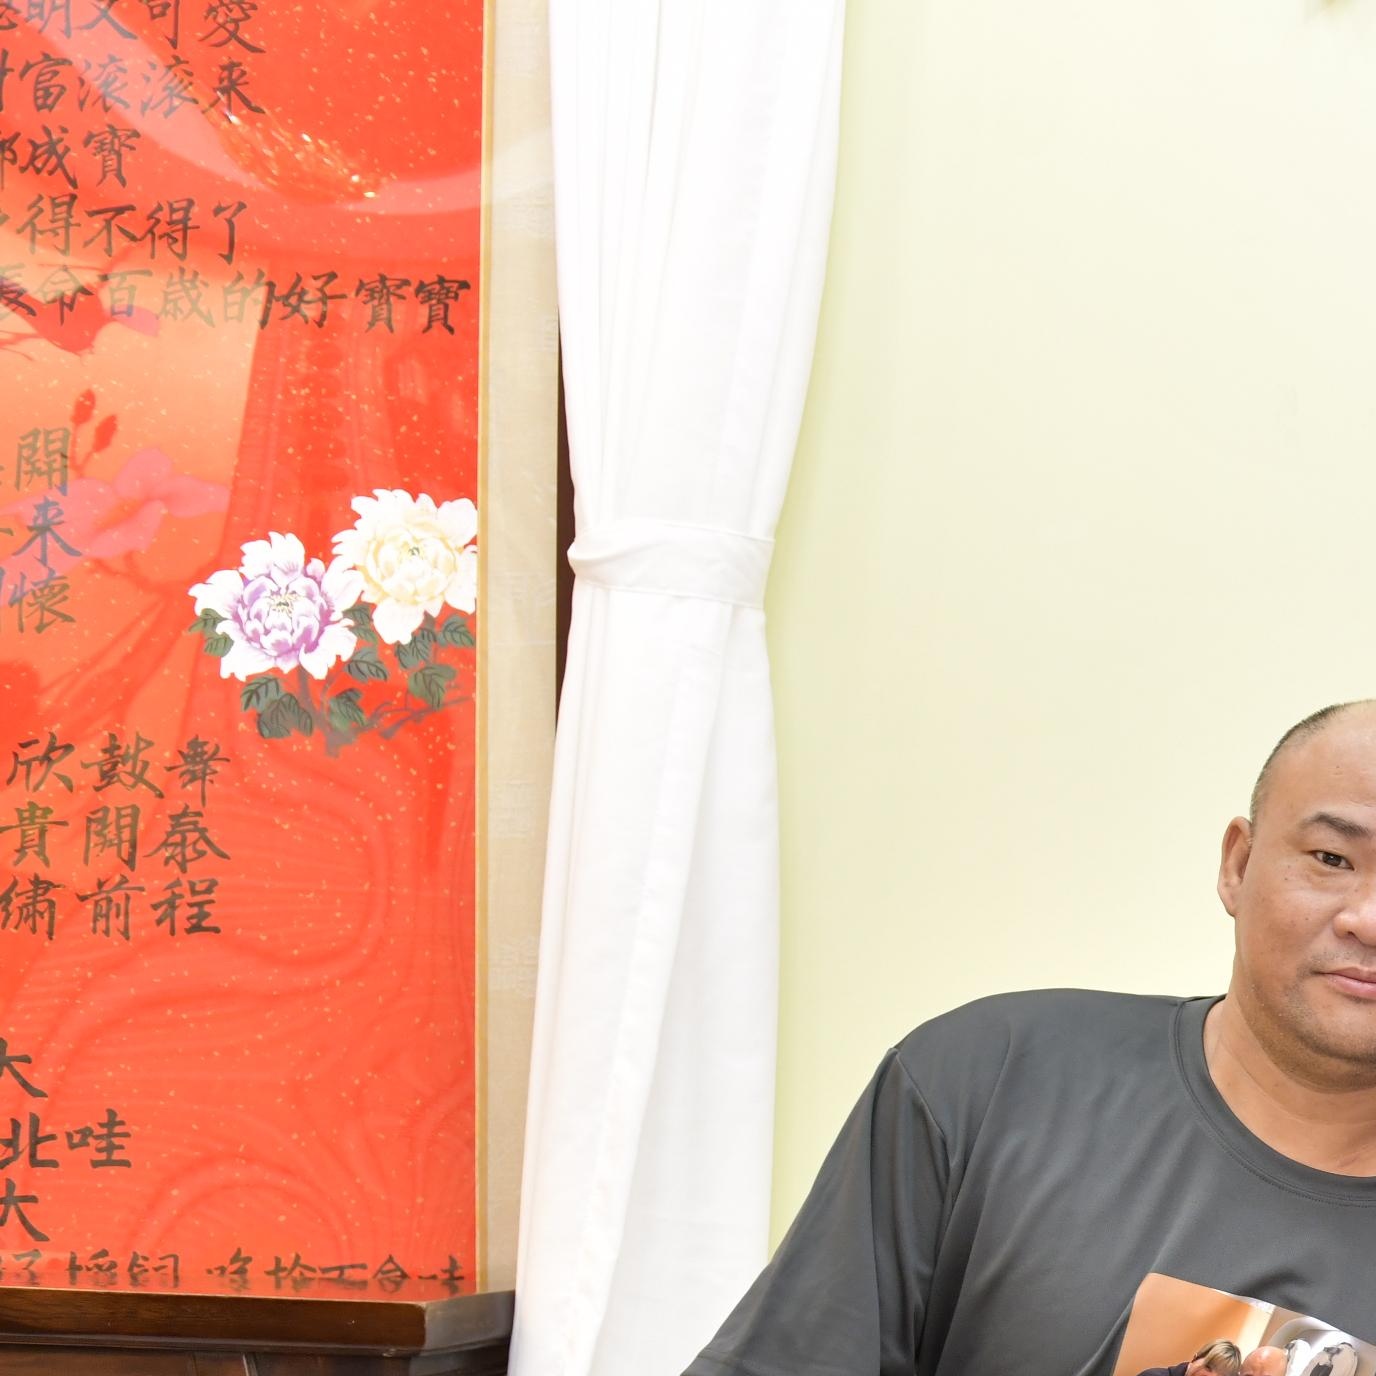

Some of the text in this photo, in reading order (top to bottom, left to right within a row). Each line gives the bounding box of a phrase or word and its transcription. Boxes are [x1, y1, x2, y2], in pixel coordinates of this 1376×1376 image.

[0, 0, 266, 53] 明又可愛
[0, 193, 247, 265] 得不得了
